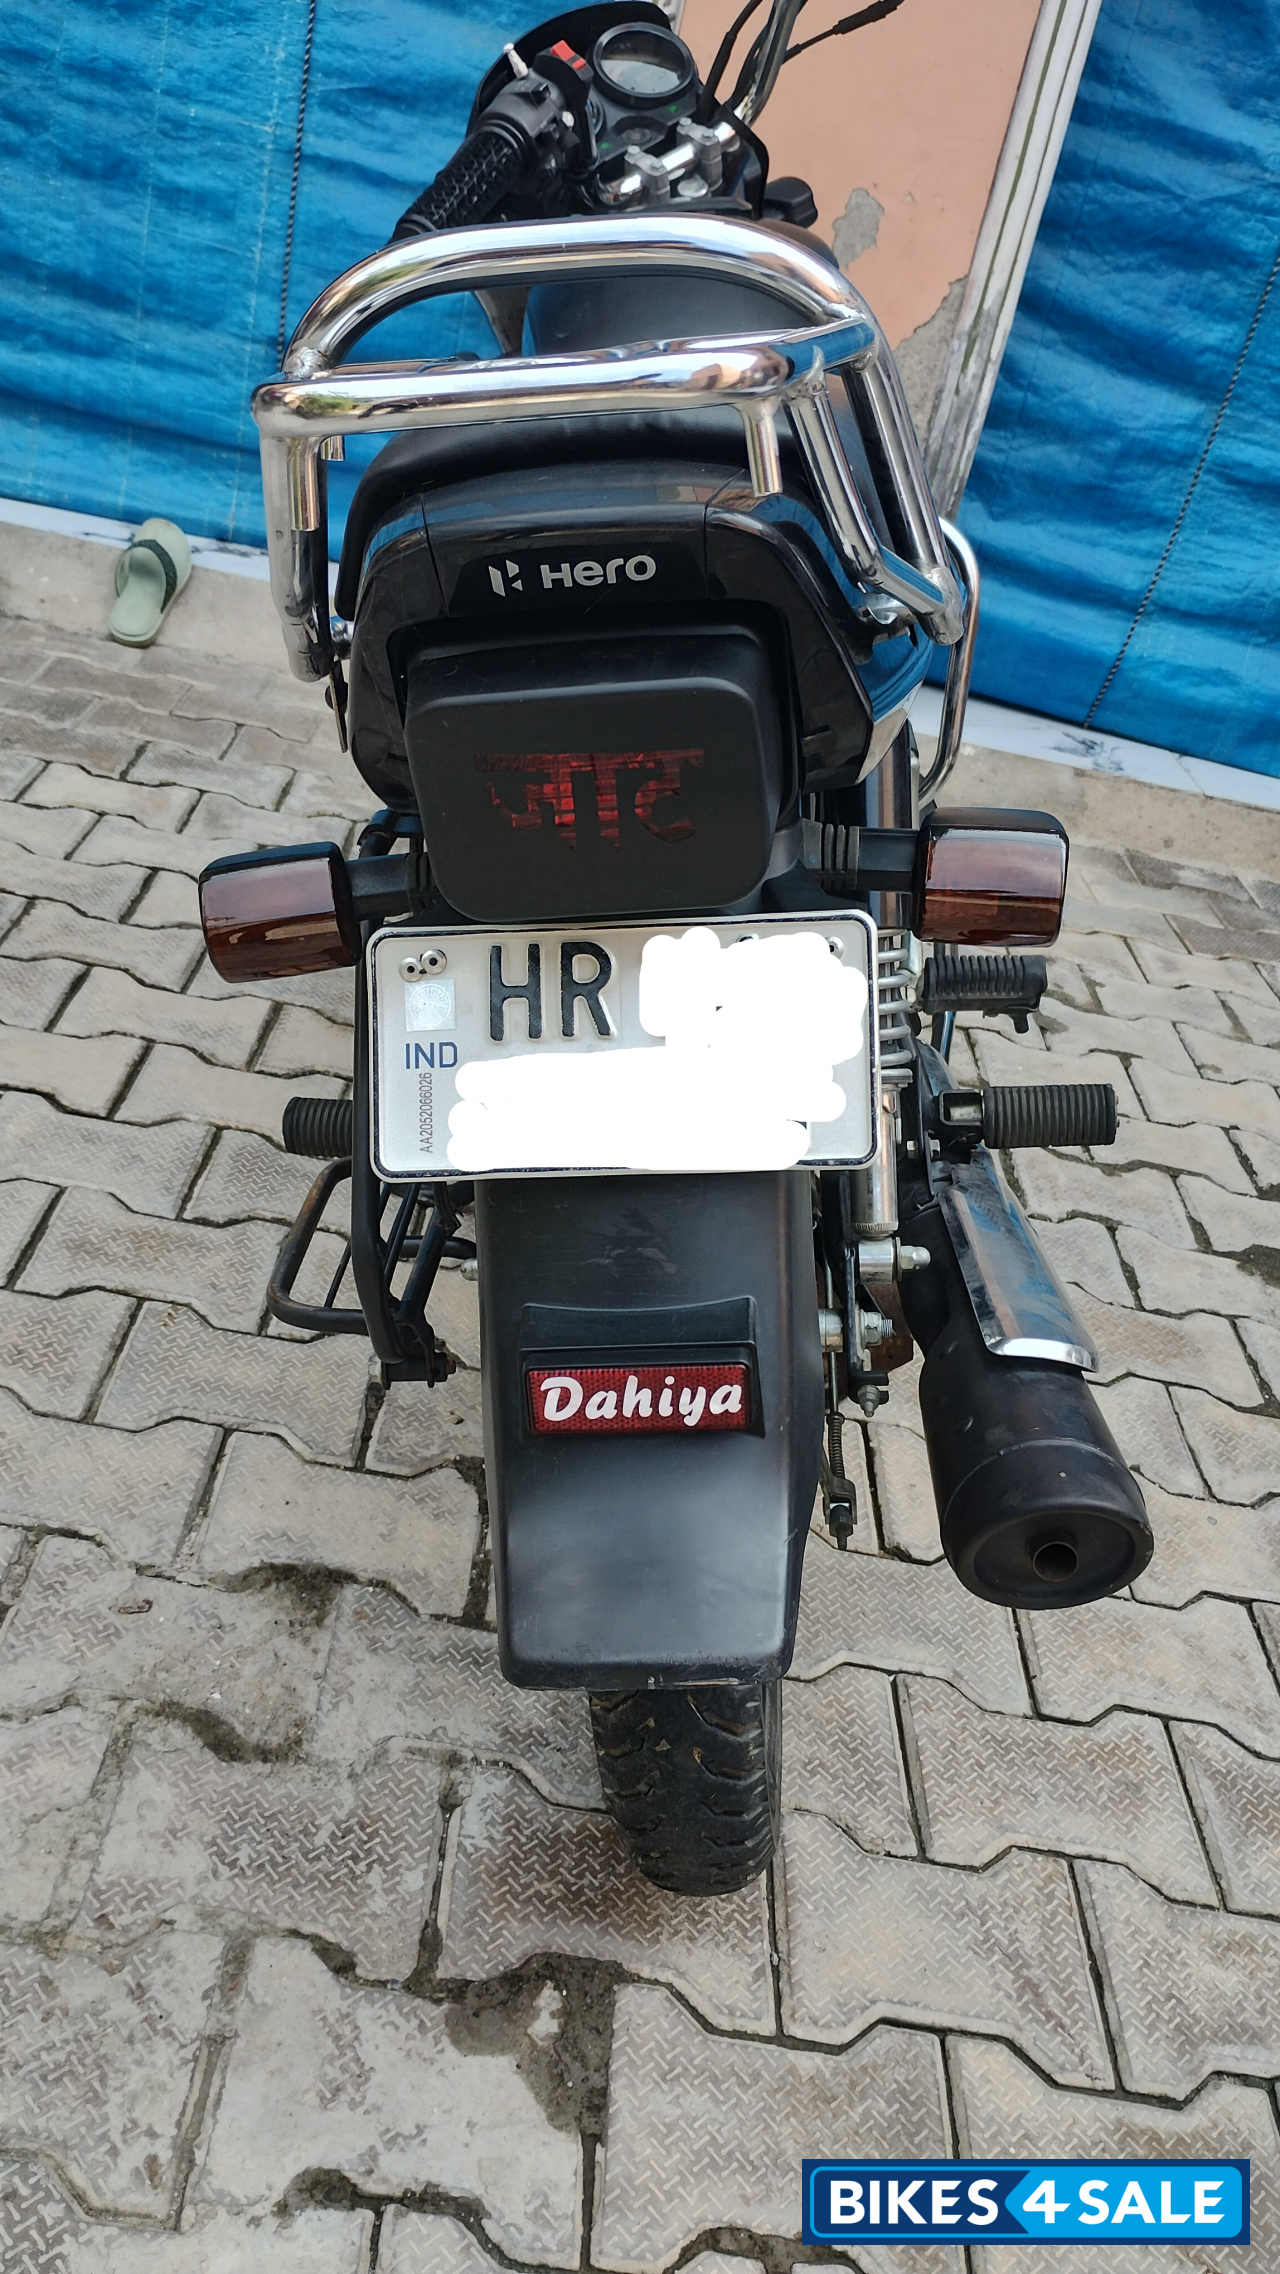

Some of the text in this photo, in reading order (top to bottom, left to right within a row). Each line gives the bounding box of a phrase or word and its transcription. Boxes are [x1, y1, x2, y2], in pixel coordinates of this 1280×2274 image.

[541, 554, 657, 589] Hero
[474, 747, 705, 854] जाट
[489, 940, 614, 1042] HR
[405, 1041, 458, 1070] IND
[418, 1071, 434, 1154] AA2052066026
[540, 1374, 743, 1427] Dahiya
